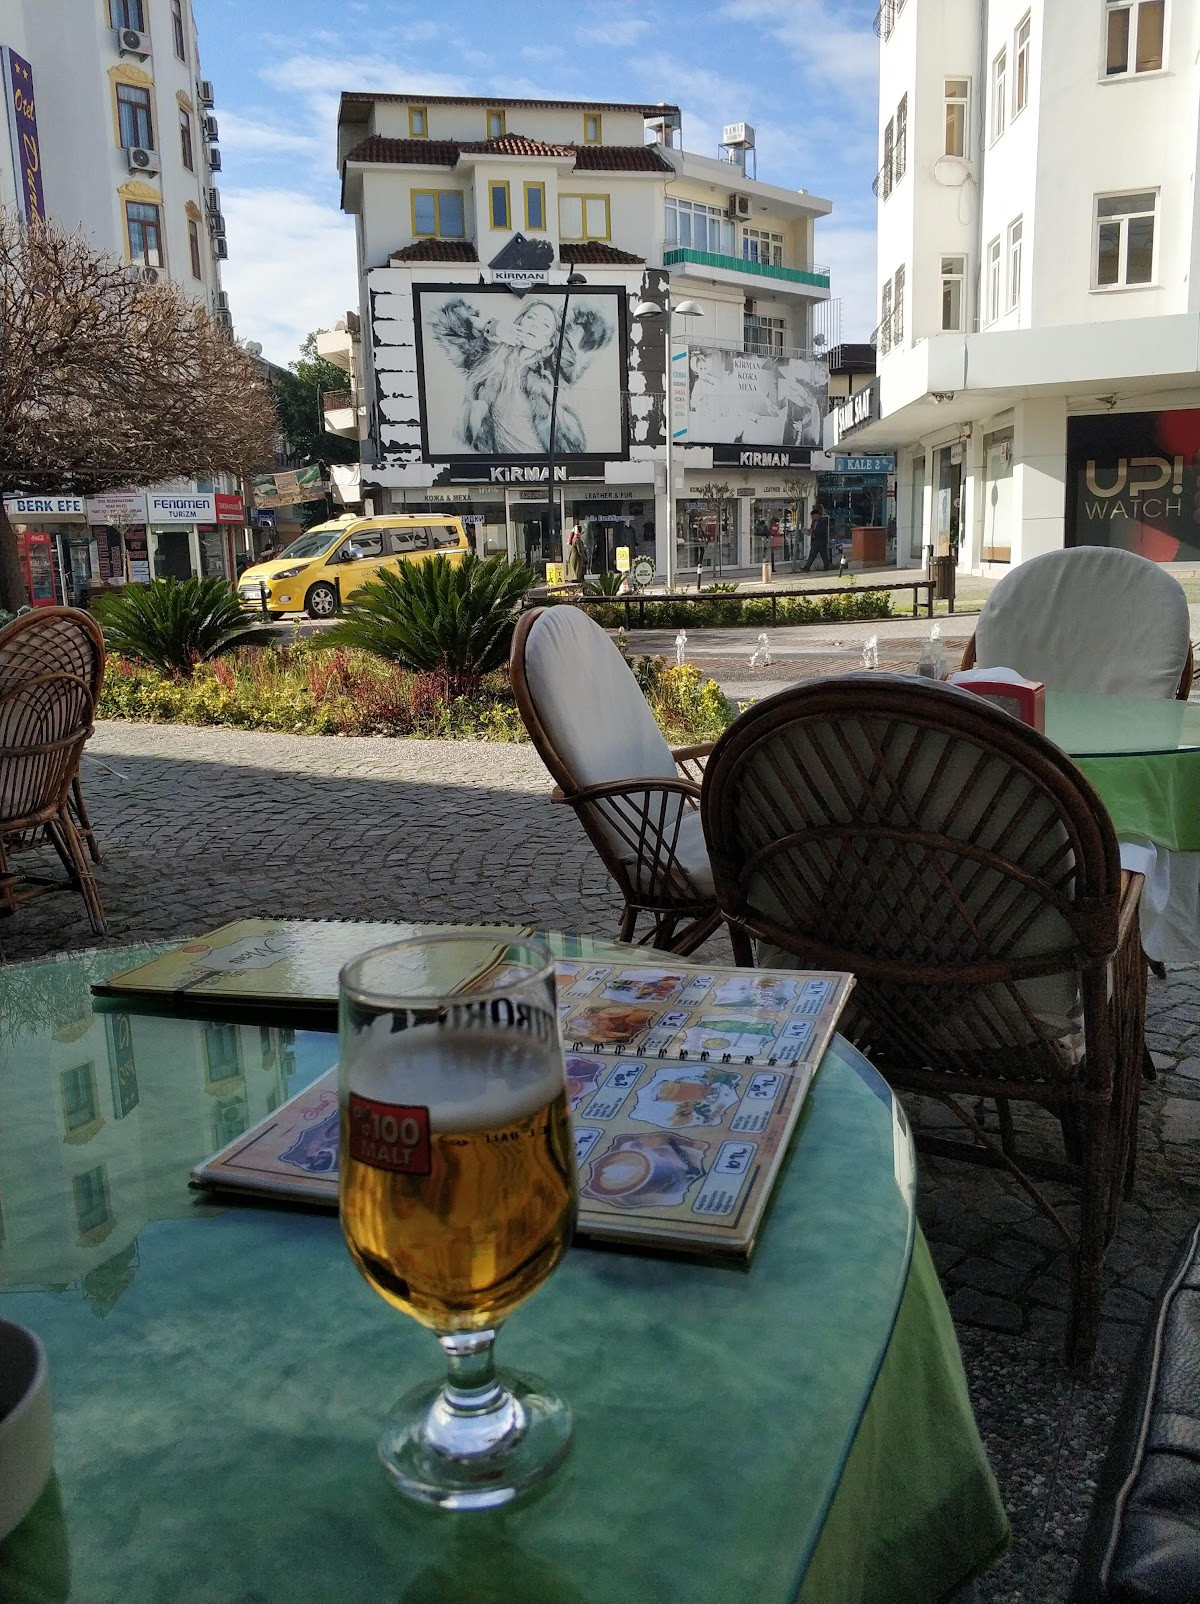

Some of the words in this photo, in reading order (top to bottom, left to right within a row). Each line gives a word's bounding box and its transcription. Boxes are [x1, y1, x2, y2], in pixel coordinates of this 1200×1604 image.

[14, 88, 34, 122] Otel
[847, 460, 872, 470] KALE
[874, 459, 880, 470] 2
[1086, 455, 1184, 498] UP!
[17, 500, 54, 512] BERK
[58, 499, 81, 511] EFE
[1085, 498, 1182, 520] WATCH
[362, 1140, 414, 1165] MALT
